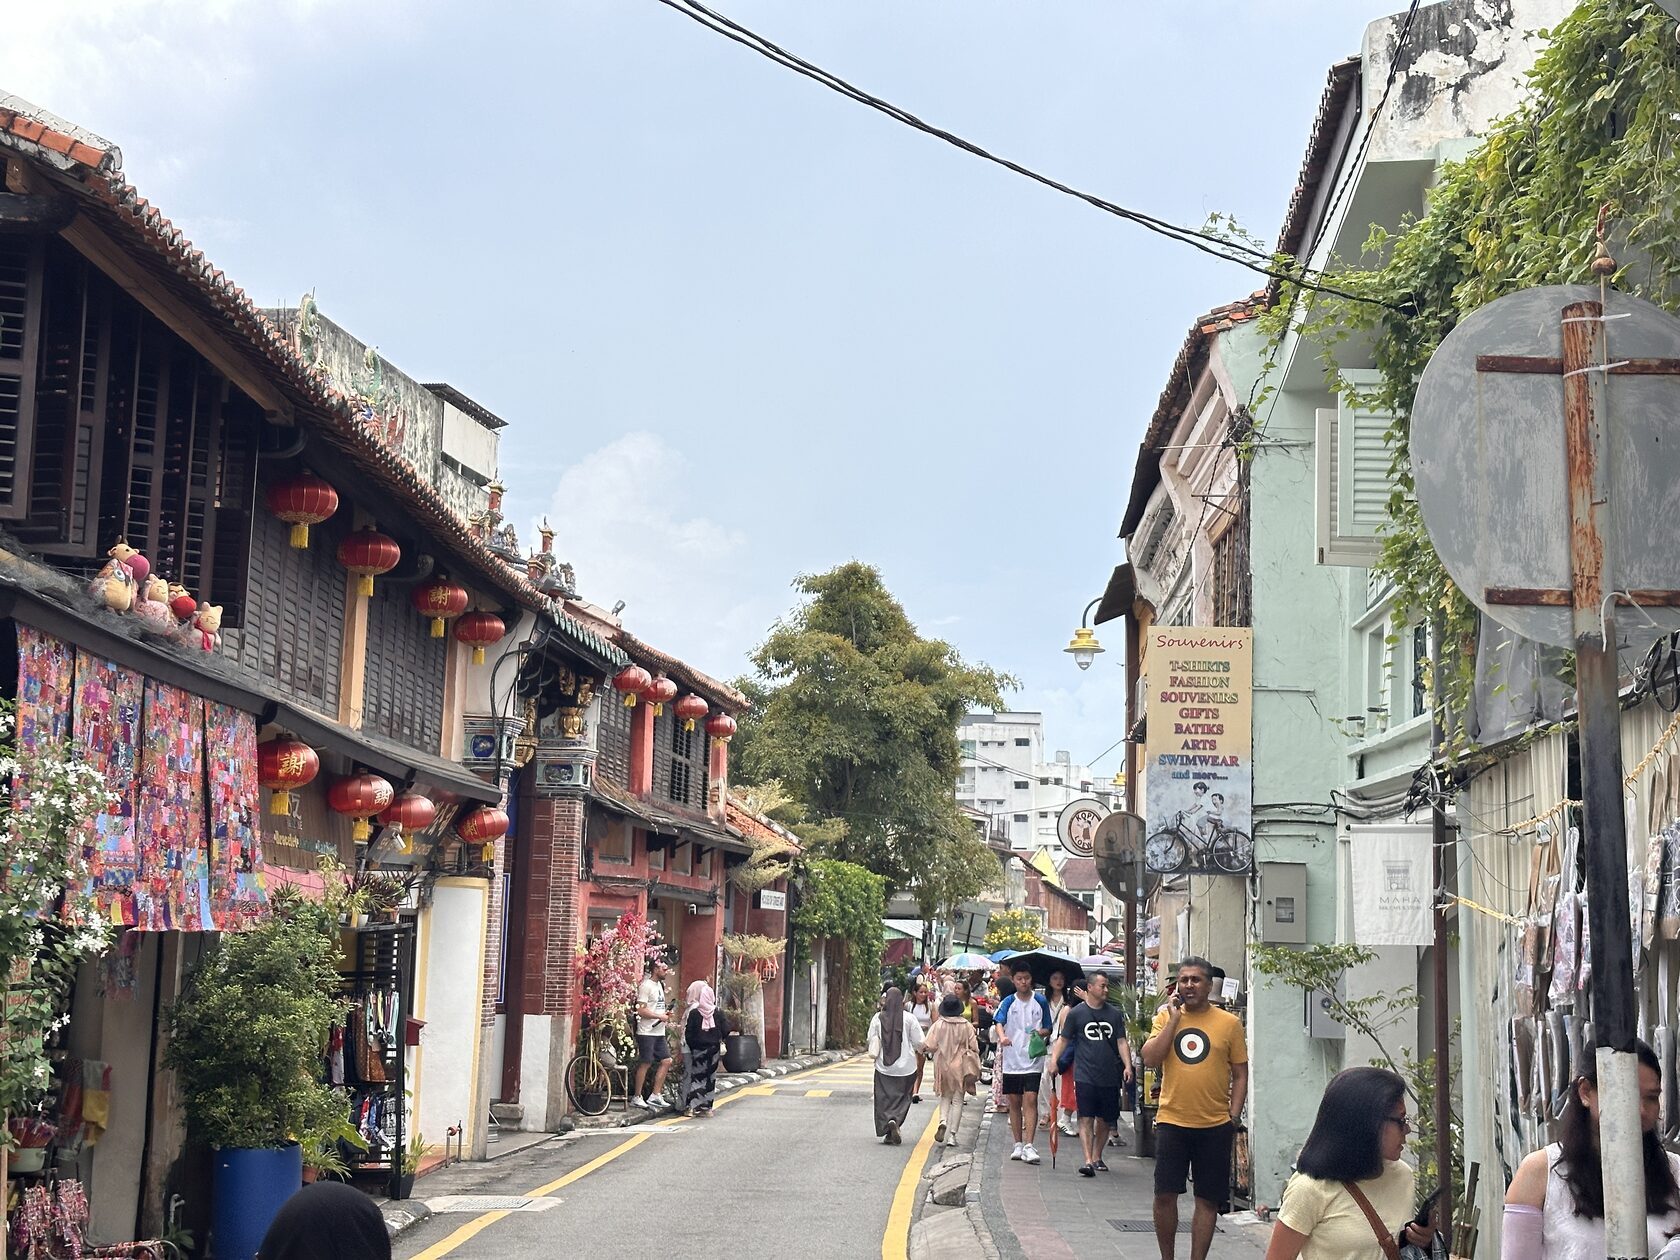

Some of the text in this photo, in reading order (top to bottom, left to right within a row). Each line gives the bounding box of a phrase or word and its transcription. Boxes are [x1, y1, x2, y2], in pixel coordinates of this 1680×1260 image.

[1157, 634, 1243, 650] Souvenirs
[1169, 660, 1231, 673] T-SHIRTS
[1169, 675, 1230, 688] FASHION
[1160, 691, 1239, 704] SOUVENIRS
[1178, 707, 1220, 720] GIFTS
[1174, 723, 1224, 735] BATIKS
[1181, 738, 1217, 751] ARTS
[1158, 753, 1240, 767] SWIMWEAR
[1171, 769, 1190, 780] and
